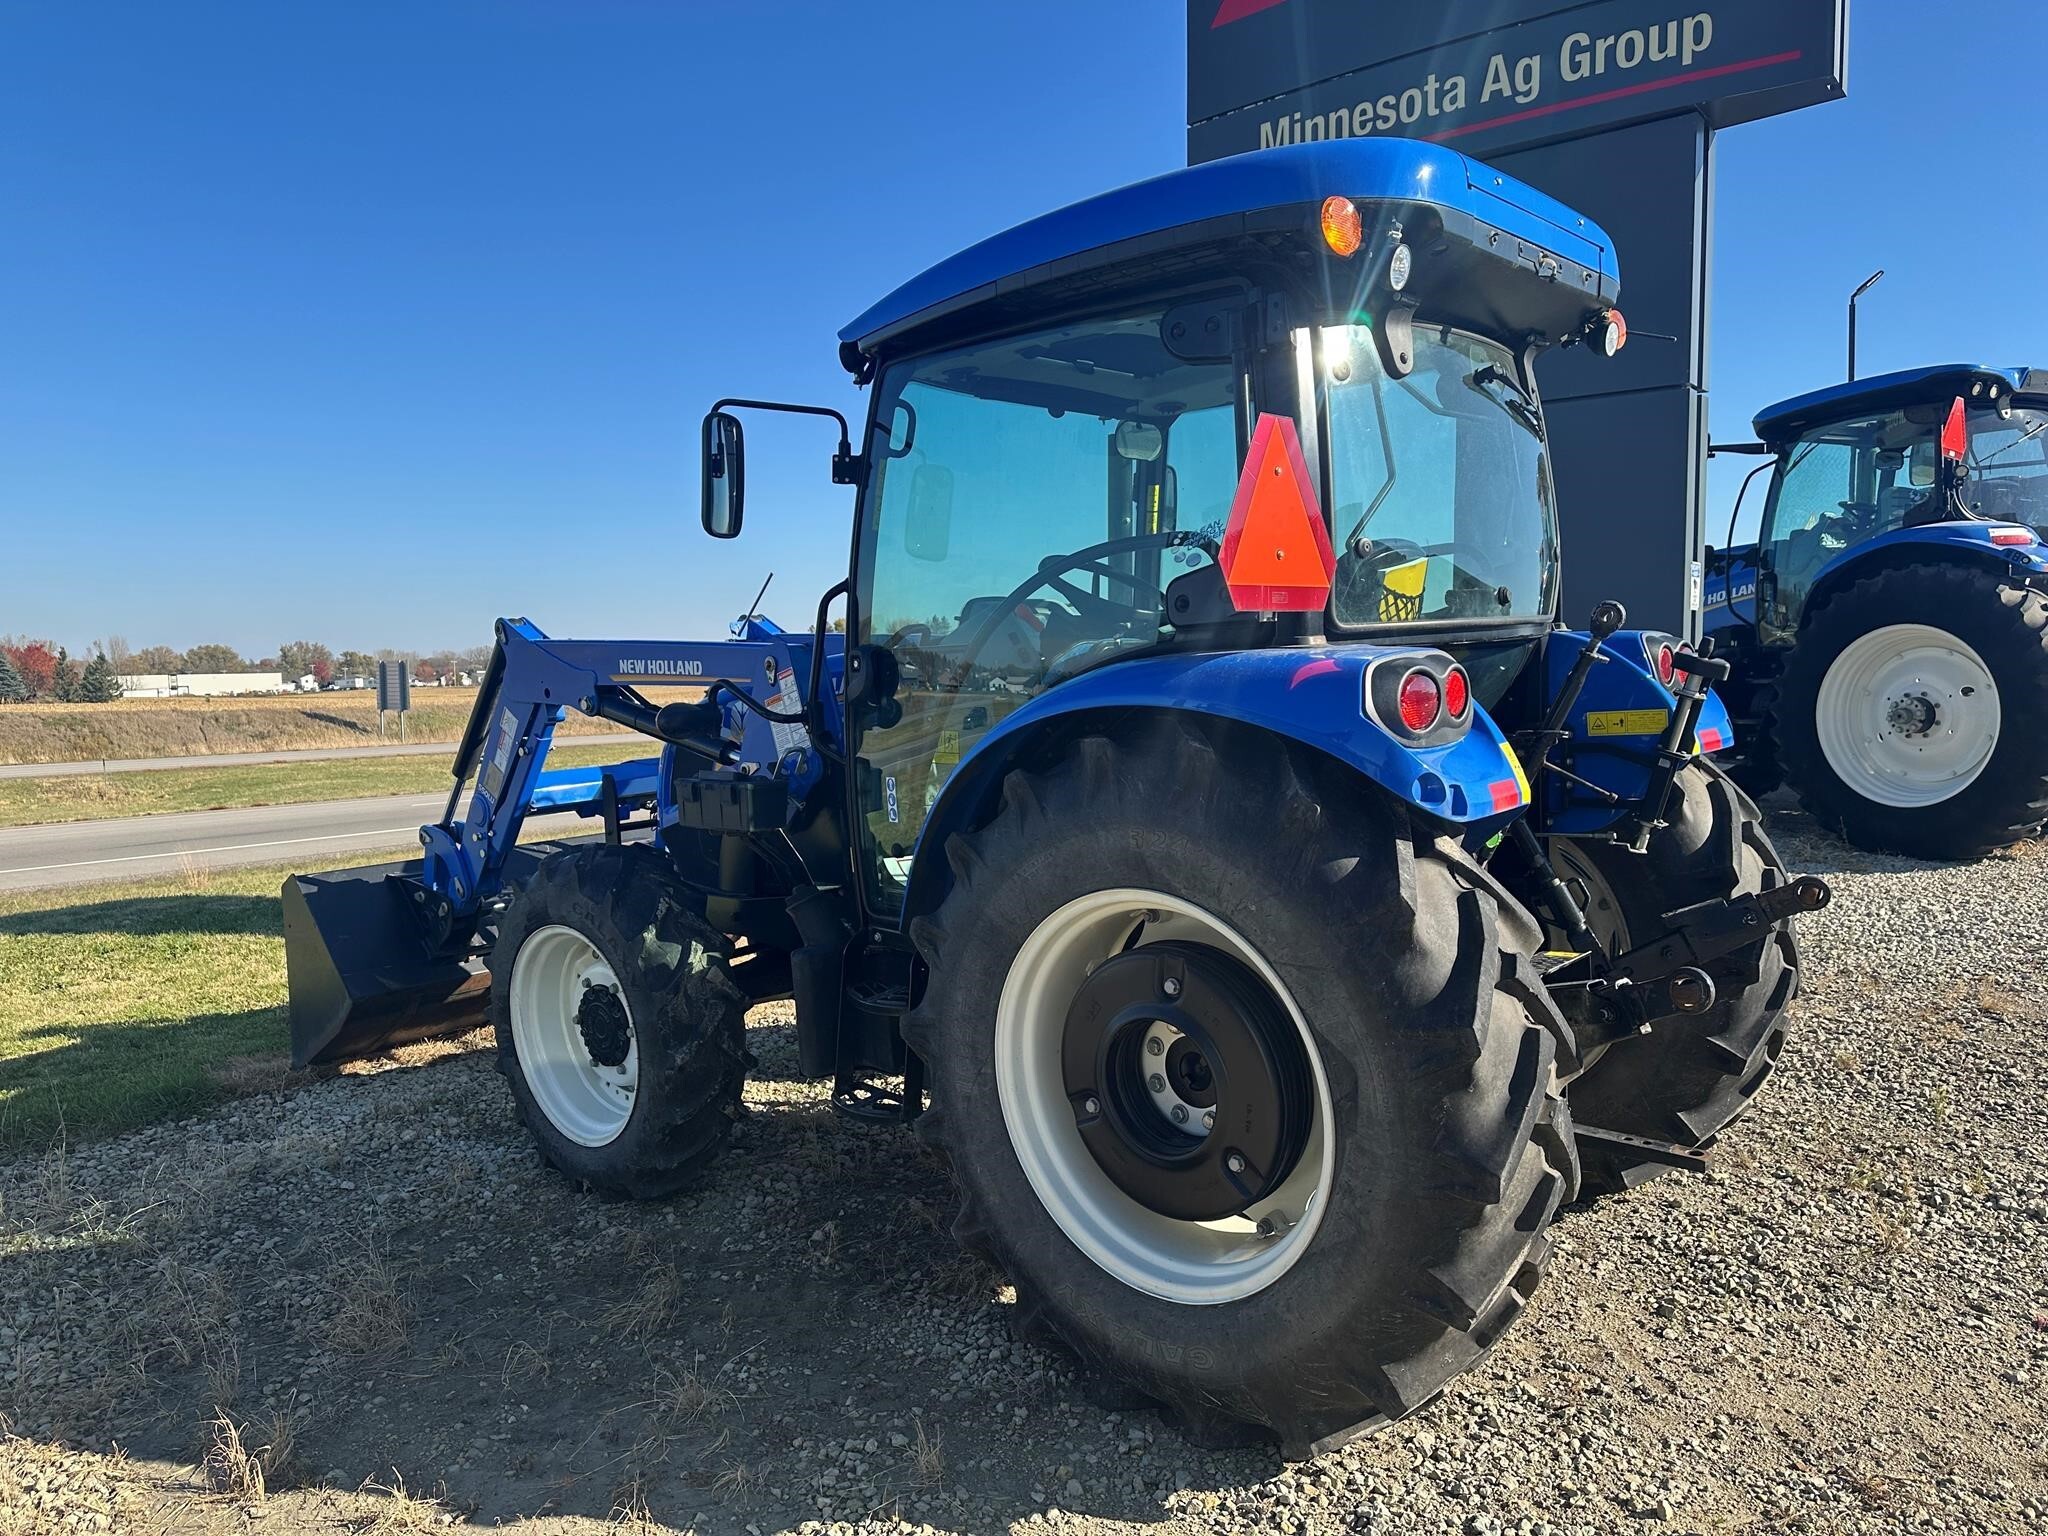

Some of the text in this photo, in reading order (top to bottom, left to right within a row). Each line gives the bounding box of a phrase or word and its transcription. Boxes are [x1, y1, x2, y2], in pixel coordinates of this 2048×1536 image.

[1258, 12, 1713, 150] Minnesota Ag Group
[1707, 583, 1756, 605] HOLAN
[618, 659, 703, 676] NEW HOLLAND
